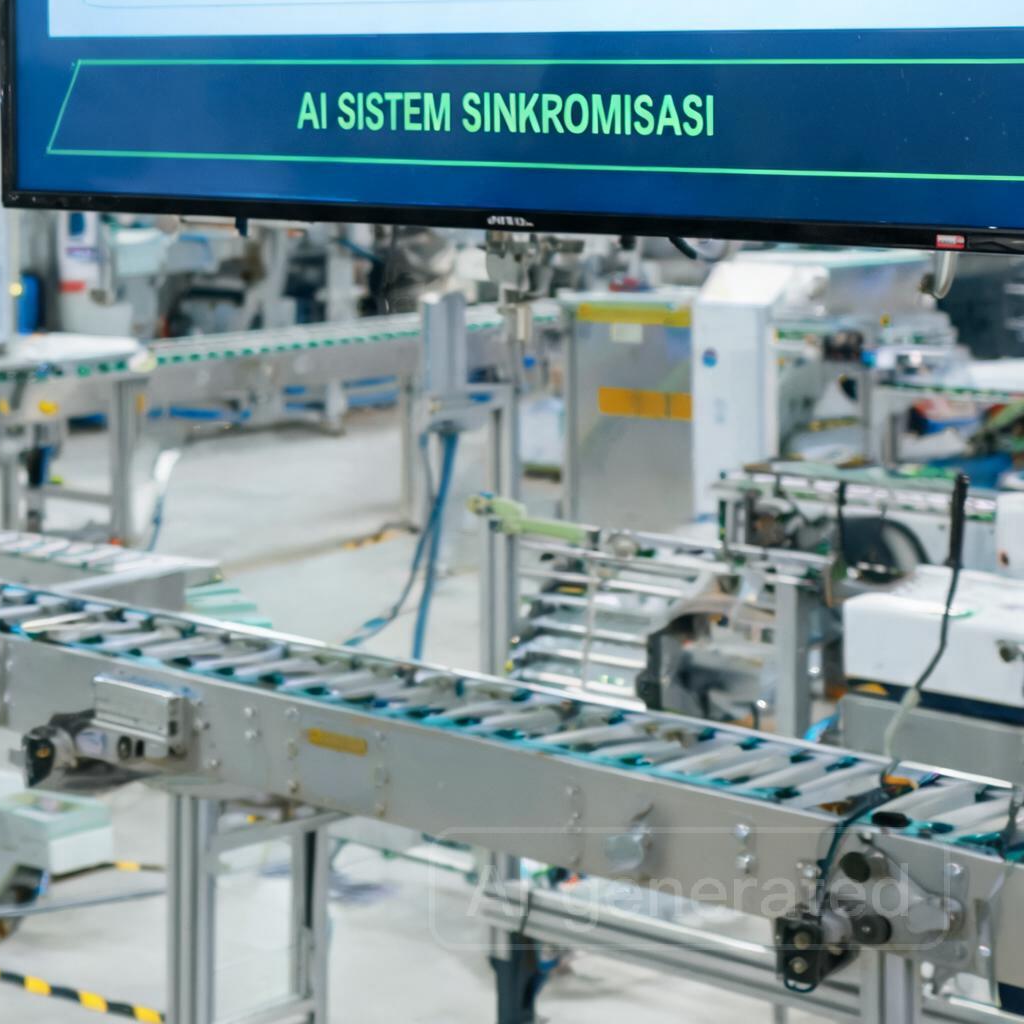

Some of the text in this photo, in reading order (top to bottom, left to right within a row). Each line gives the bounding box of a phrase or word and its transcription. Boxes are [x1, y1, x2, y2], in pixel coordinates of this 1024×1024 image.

[297, 91, 714, 137] AI SISTEM SINKROMISASI
